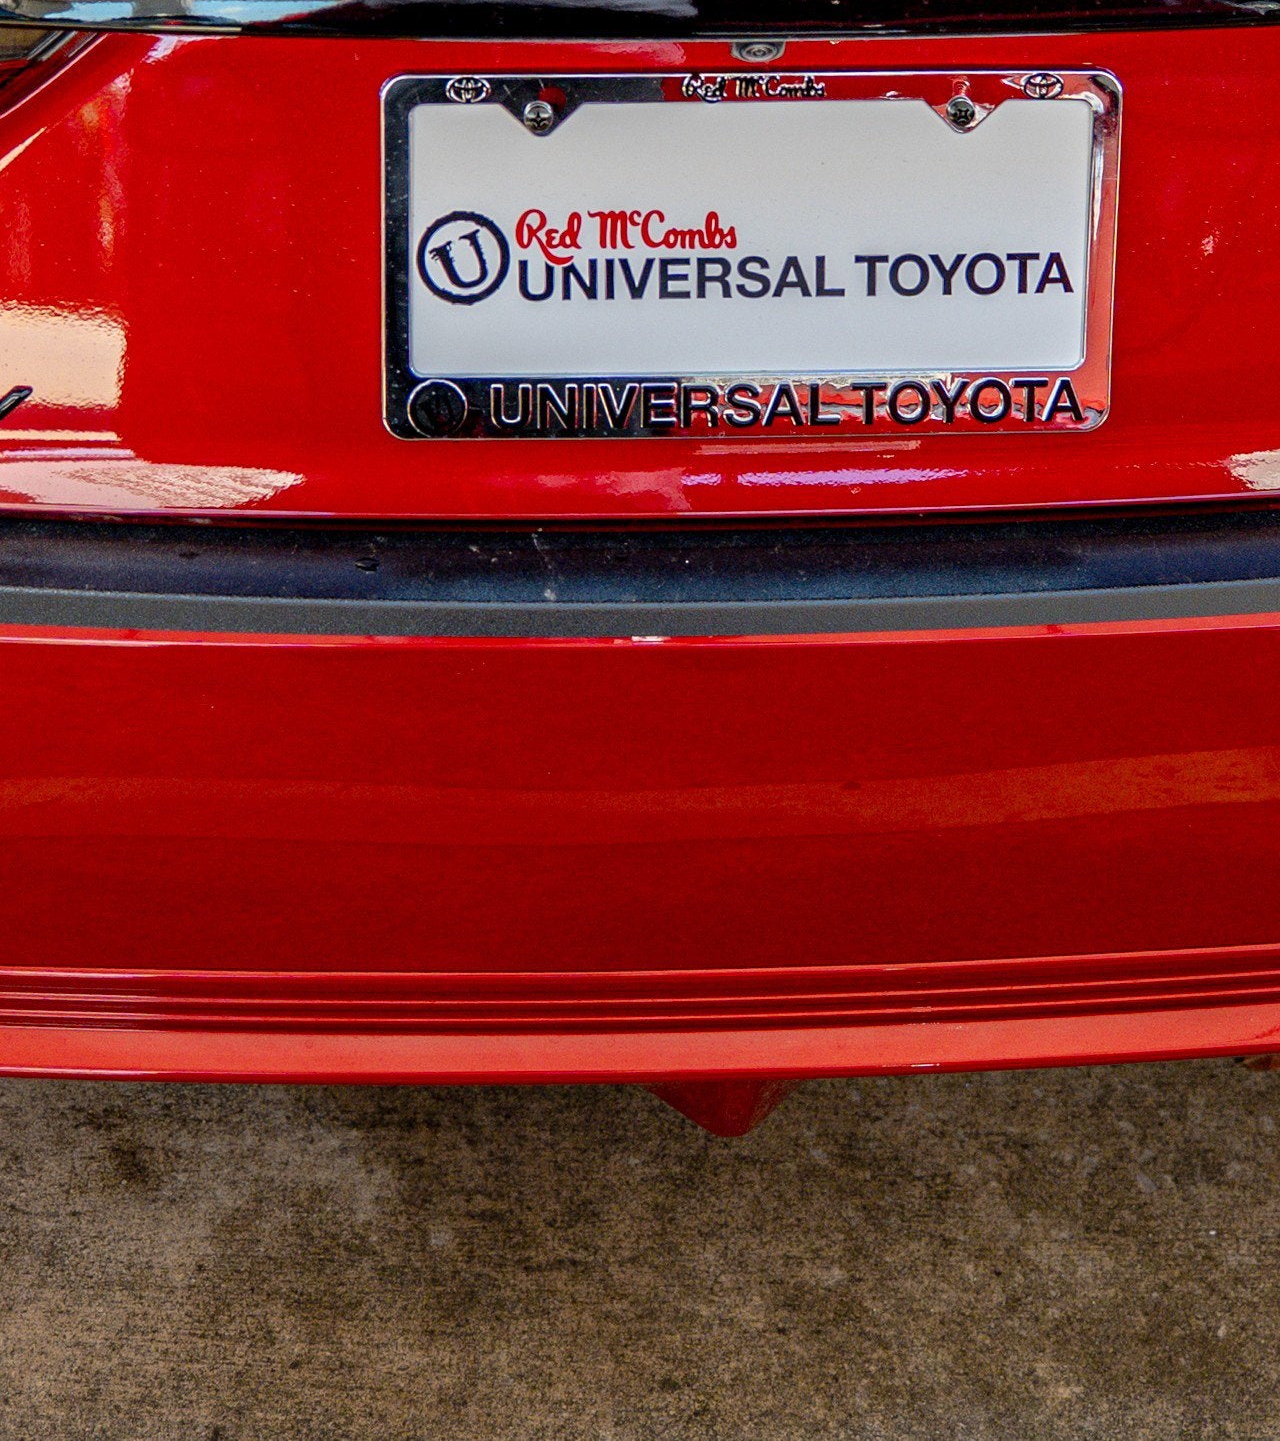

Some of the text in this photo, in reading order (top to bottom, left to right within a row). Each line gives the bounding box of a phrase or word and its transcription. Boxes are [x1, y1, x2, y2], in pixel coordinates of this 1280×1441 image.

[682, 72, 728, 103] Red
[515, 209, 738, 266] Red McCombs
[518, 252, 1075, 301] UNIVERSAL TOYOTA
[489, 378, 842, 430] UNIVERSAL
[851, 376, 1085, 426] TOYOTA
